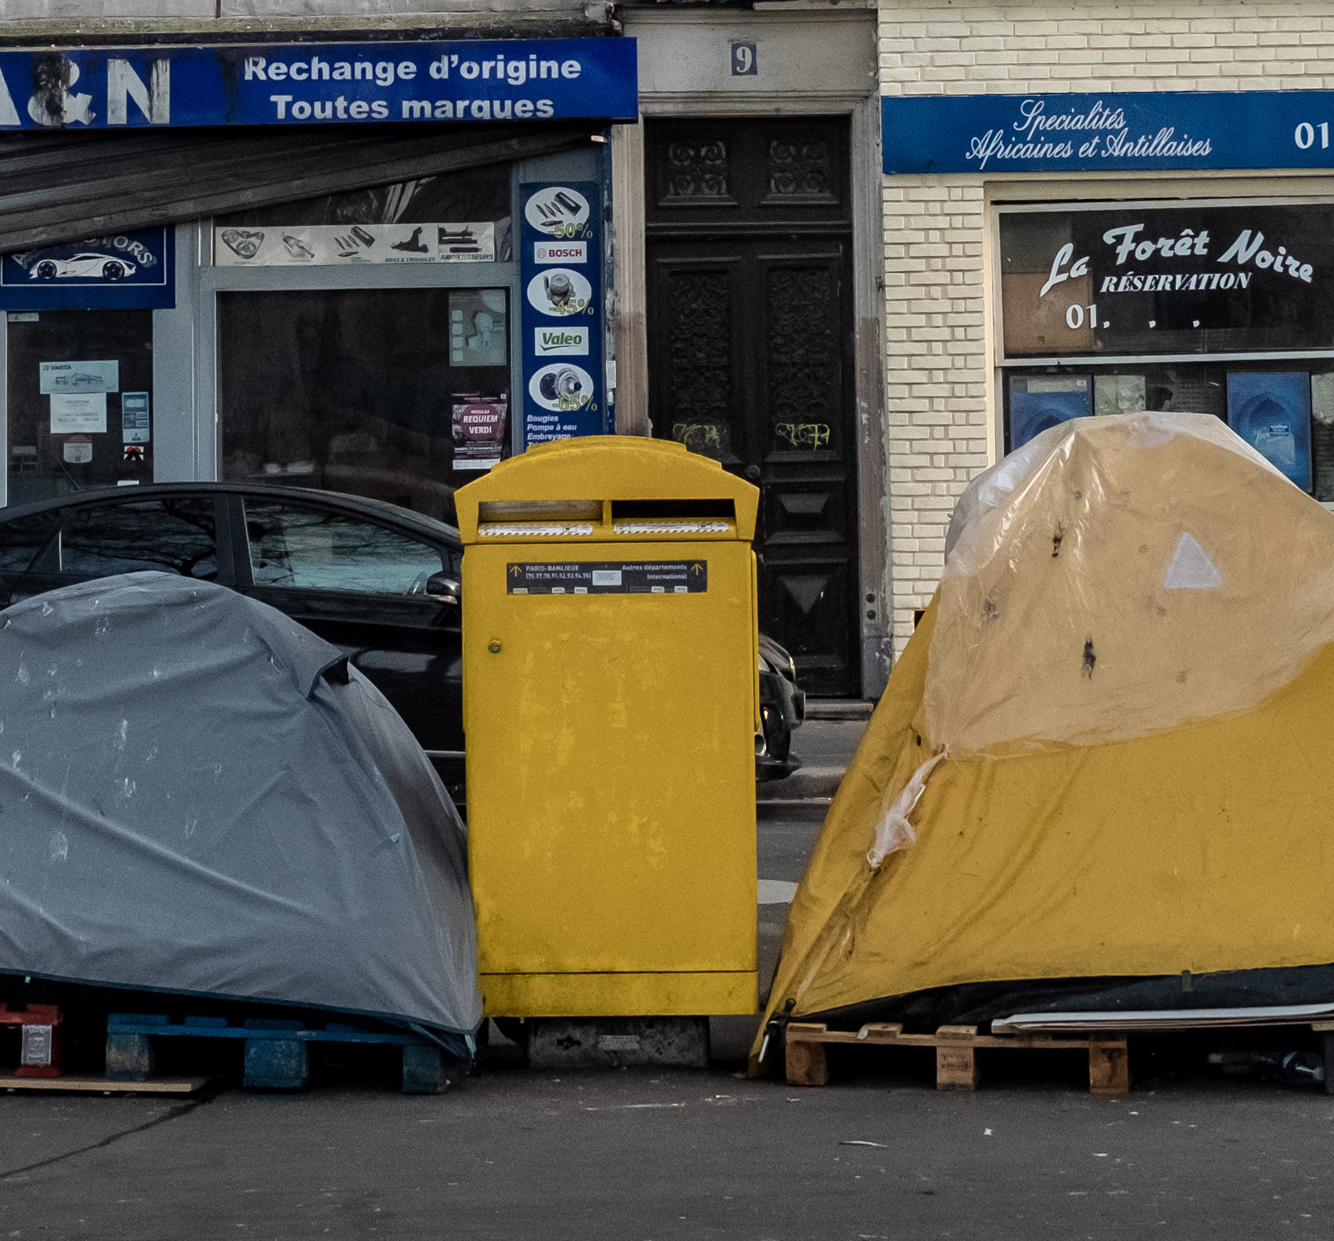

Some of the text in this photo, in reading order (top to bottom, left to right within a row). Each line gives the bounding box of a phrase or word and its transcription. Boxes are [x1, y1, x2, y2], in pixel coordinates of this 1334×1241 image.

[736, 46, 752, 73] 9
[244, 54, 582, 87] Rechange d'origine
[270, 95, 555, 120] Toutes marques
[1013, 99, 1127, 141] Specialités
[965, 126, 1213, 170] Africaines et Antillaises
[548, 223, 593, 238] -50%
[548, 249, 582, 258] BOSCH
[1040, 223, 1314, 298] La Forêt Noire
[1099, 271, 1252, 293] RÉSERVATION
[549, 298, 595, 315] -45%
[542, 332, 582, 345] Valeo
[552, 395, 598, 411] -65%
[527, 414, 559, 423] Bougies
[527, 424, 554, 432] Pompe
[644, 563, 687, 572] départements
